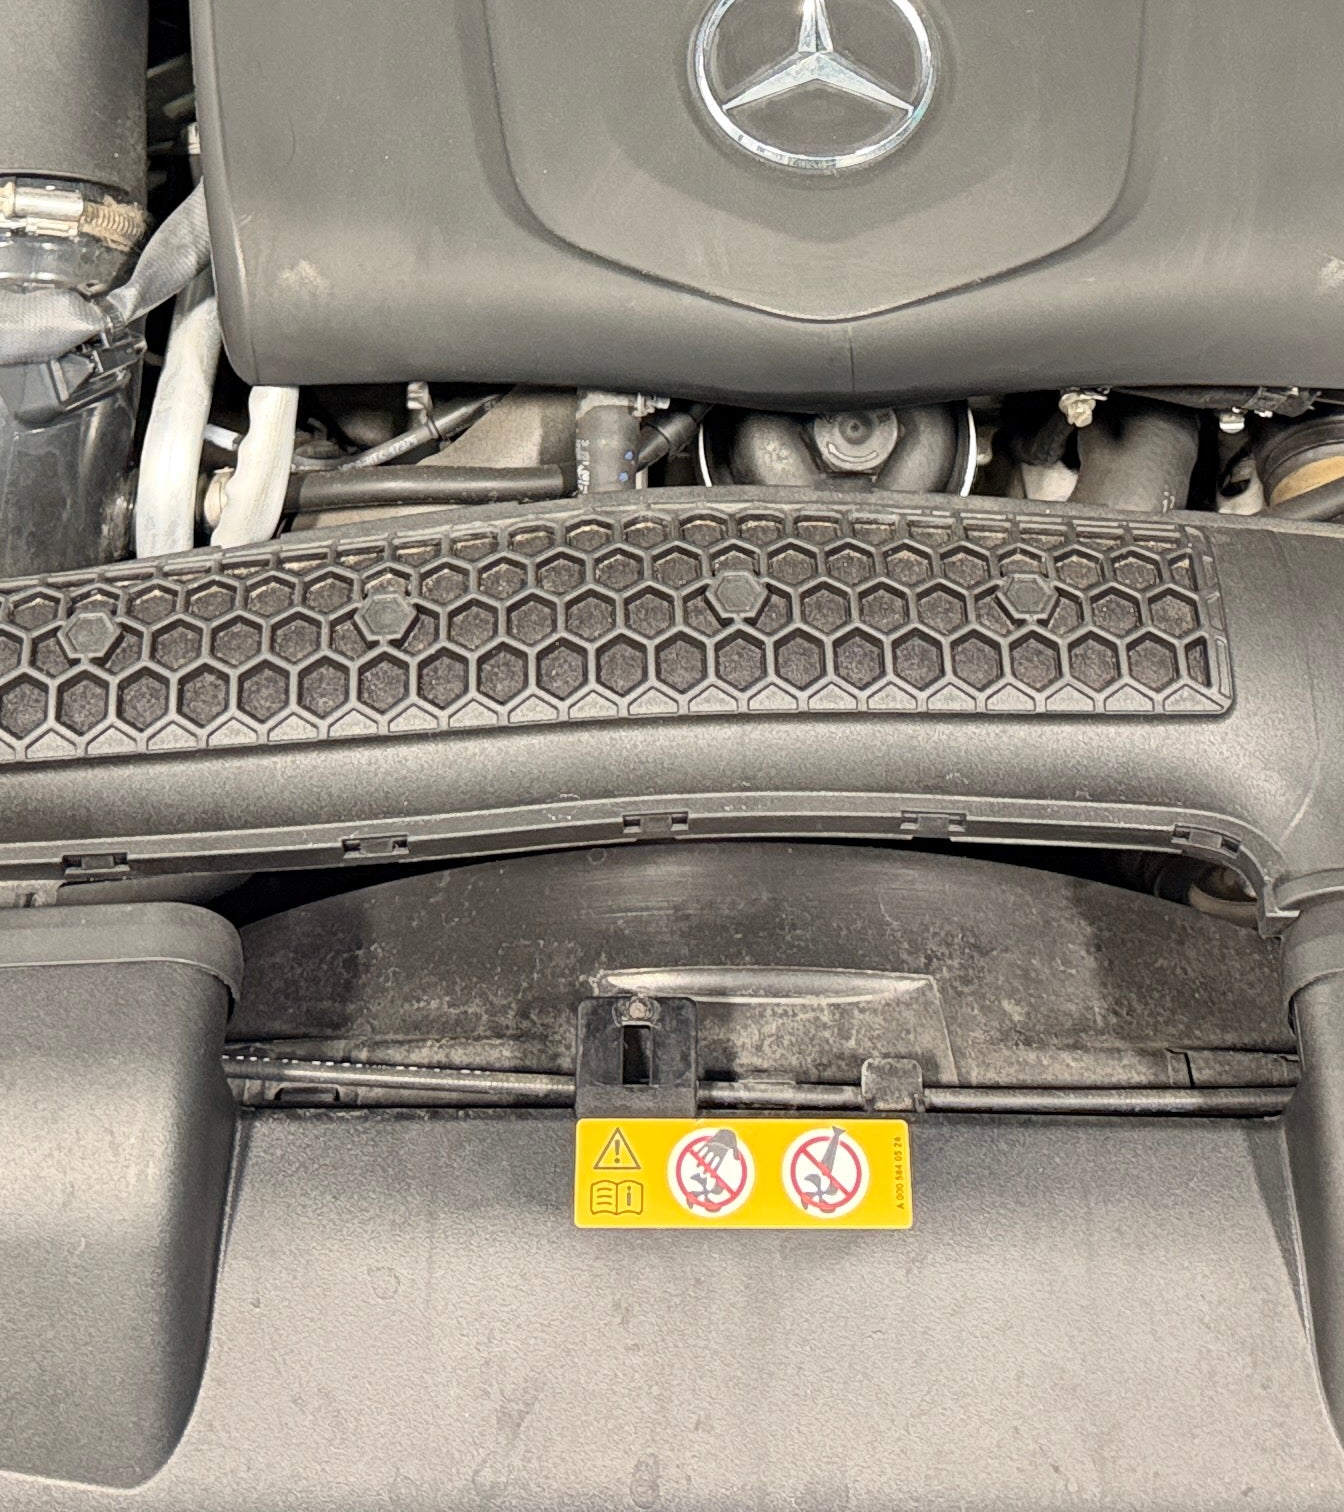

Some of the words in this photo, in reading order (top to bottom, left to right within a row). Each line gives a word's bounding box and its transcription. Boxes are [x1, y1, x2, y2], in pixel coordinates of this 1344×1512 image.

[893, 1150, 903, 1162] 05
[894, 1164, 904, 1181] 584
[895, 1182, 905, 1201] 000
[896, 1202, 905, 1210] A
